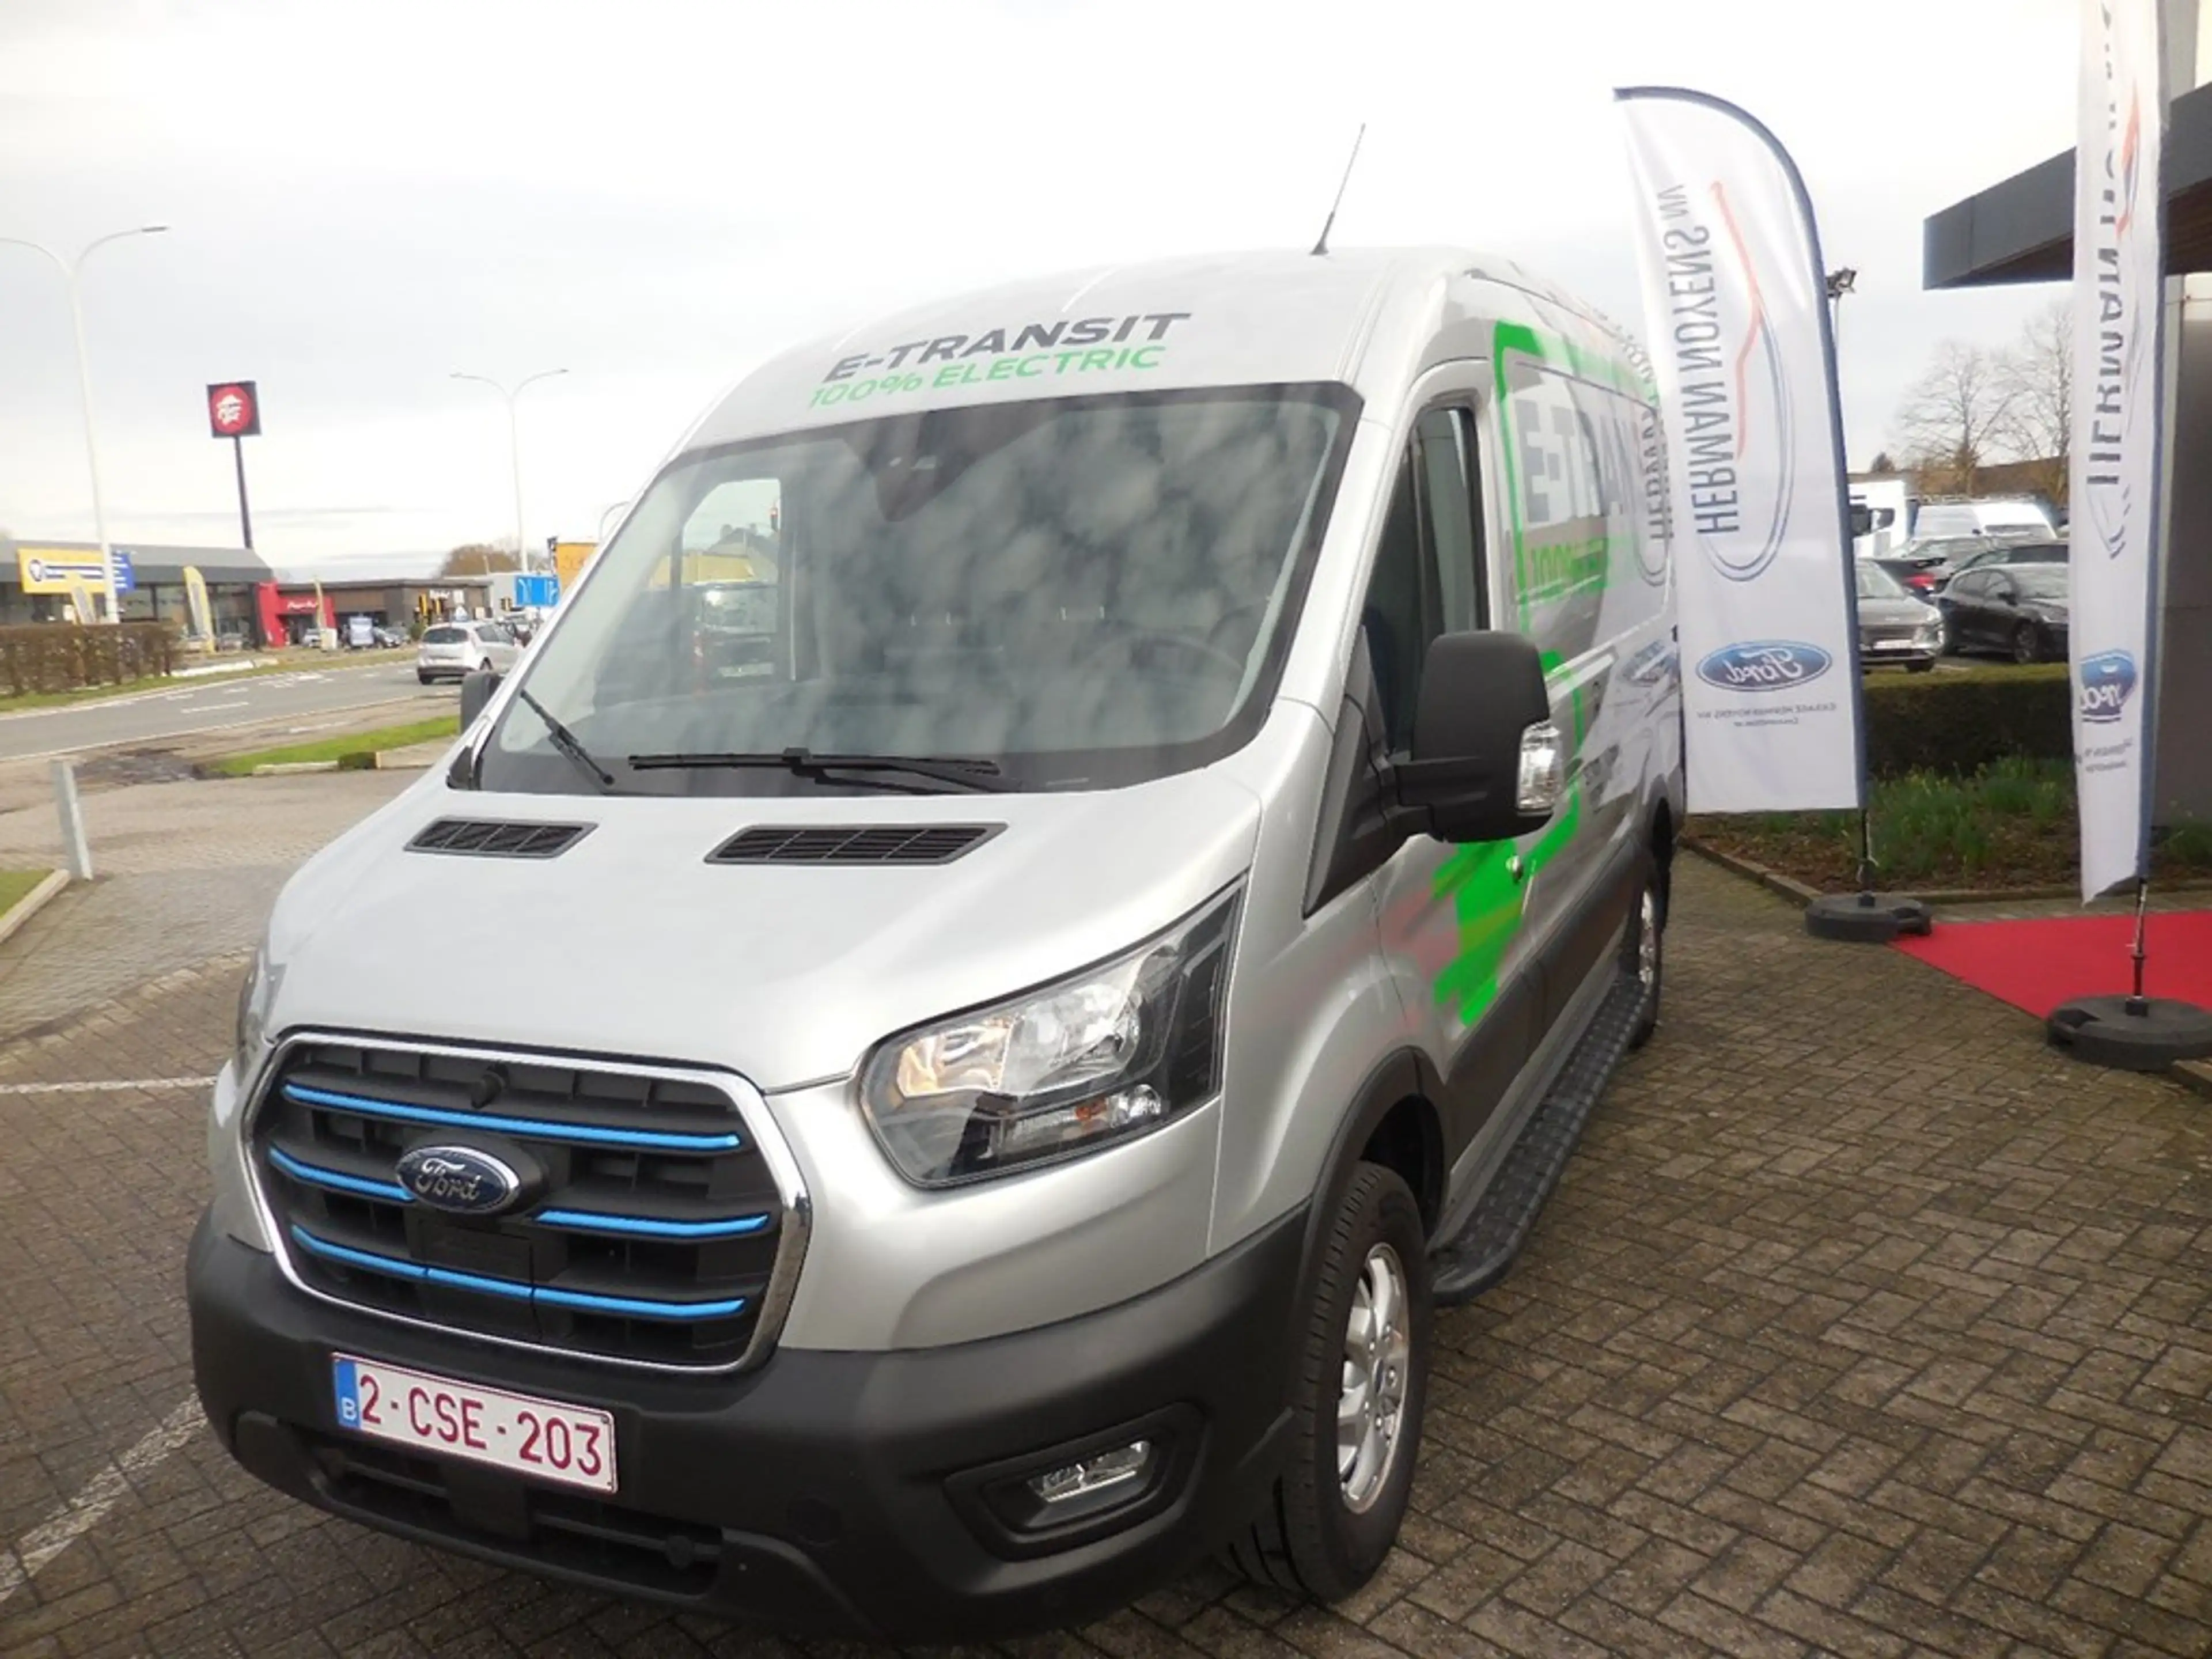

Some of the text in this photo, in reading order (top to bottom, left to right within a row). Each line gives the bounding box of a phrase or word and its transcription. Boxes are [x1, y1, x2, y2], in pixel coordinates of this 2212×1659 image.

[821, 312, 1192, 384] E-TRANSIT
[809, 346, 1166, 408] 100% ELECTRIC
[414, 1157, 482, 1200] Ford
[340, 1396, 357, 1421] B
